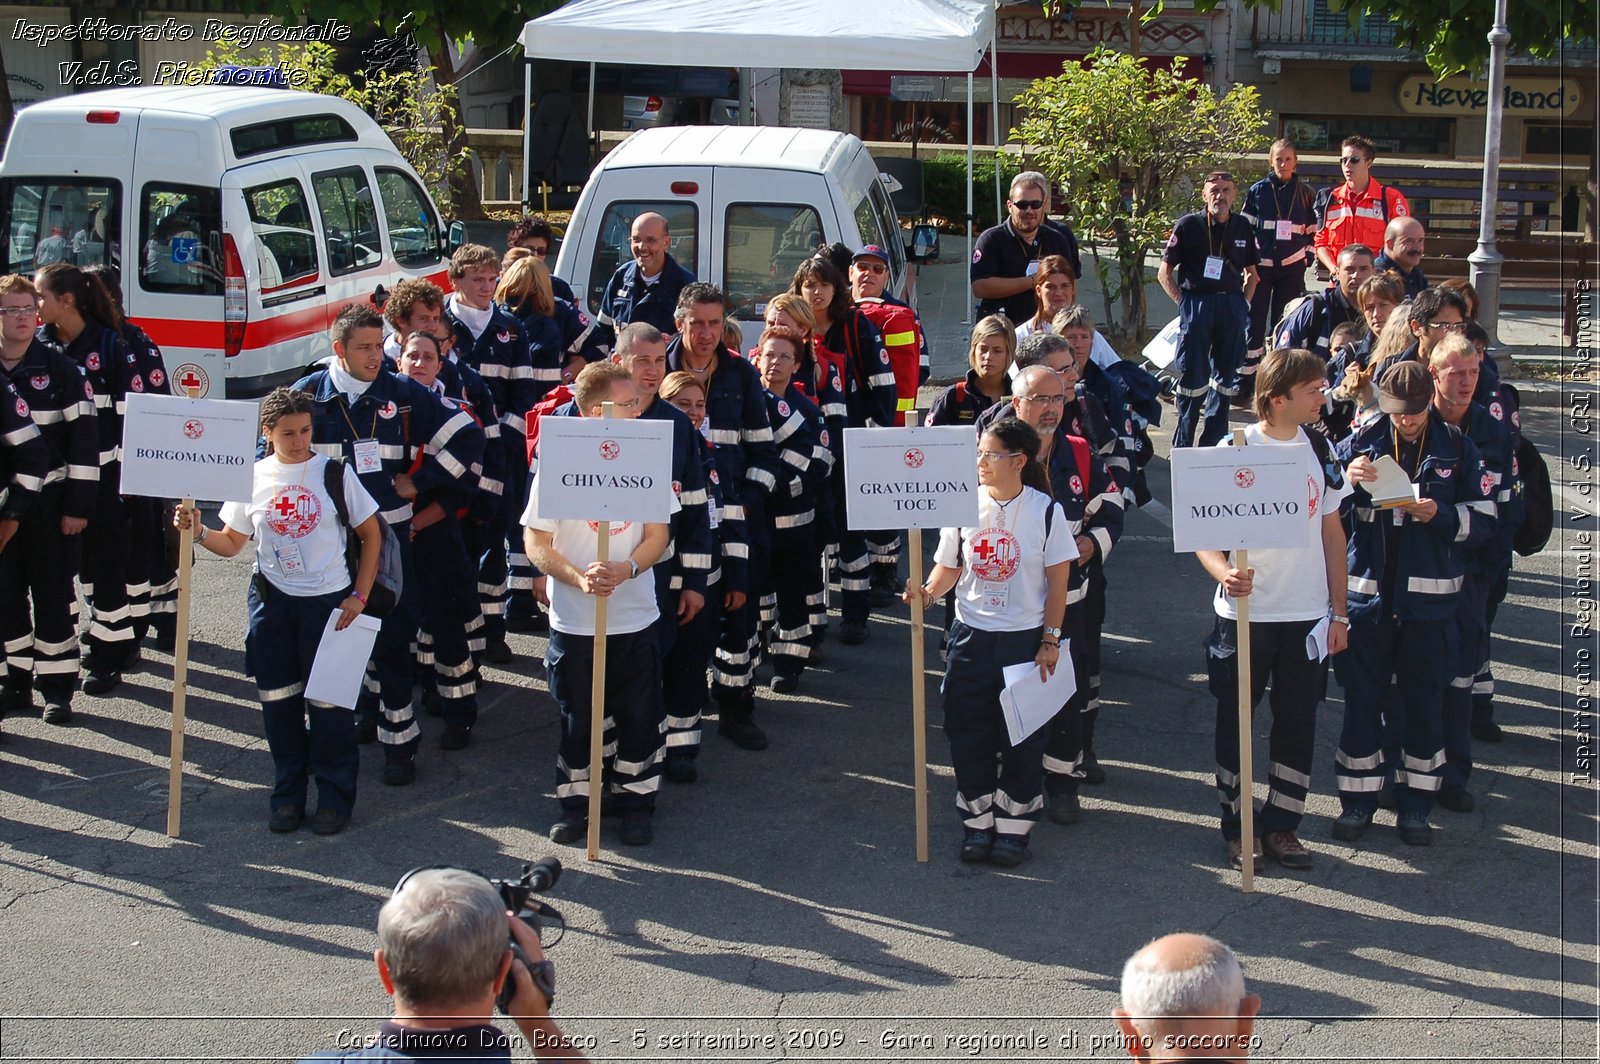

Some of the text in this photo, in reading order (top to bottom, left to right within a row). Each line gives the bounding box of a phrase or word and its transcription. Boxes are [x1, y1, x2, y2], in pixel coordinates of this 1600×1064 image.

[1415, 82, 1565, 109] Neveland
[136, 448, 245, 466] BORGOMANERO
[561, 473, 653, 489] CHIVASSO
[859, 481, 969, 495] GRAVELLONA
[893, 499, 937, 511] TOCE
[1191, 501, 1299, 519] MONCALVO
